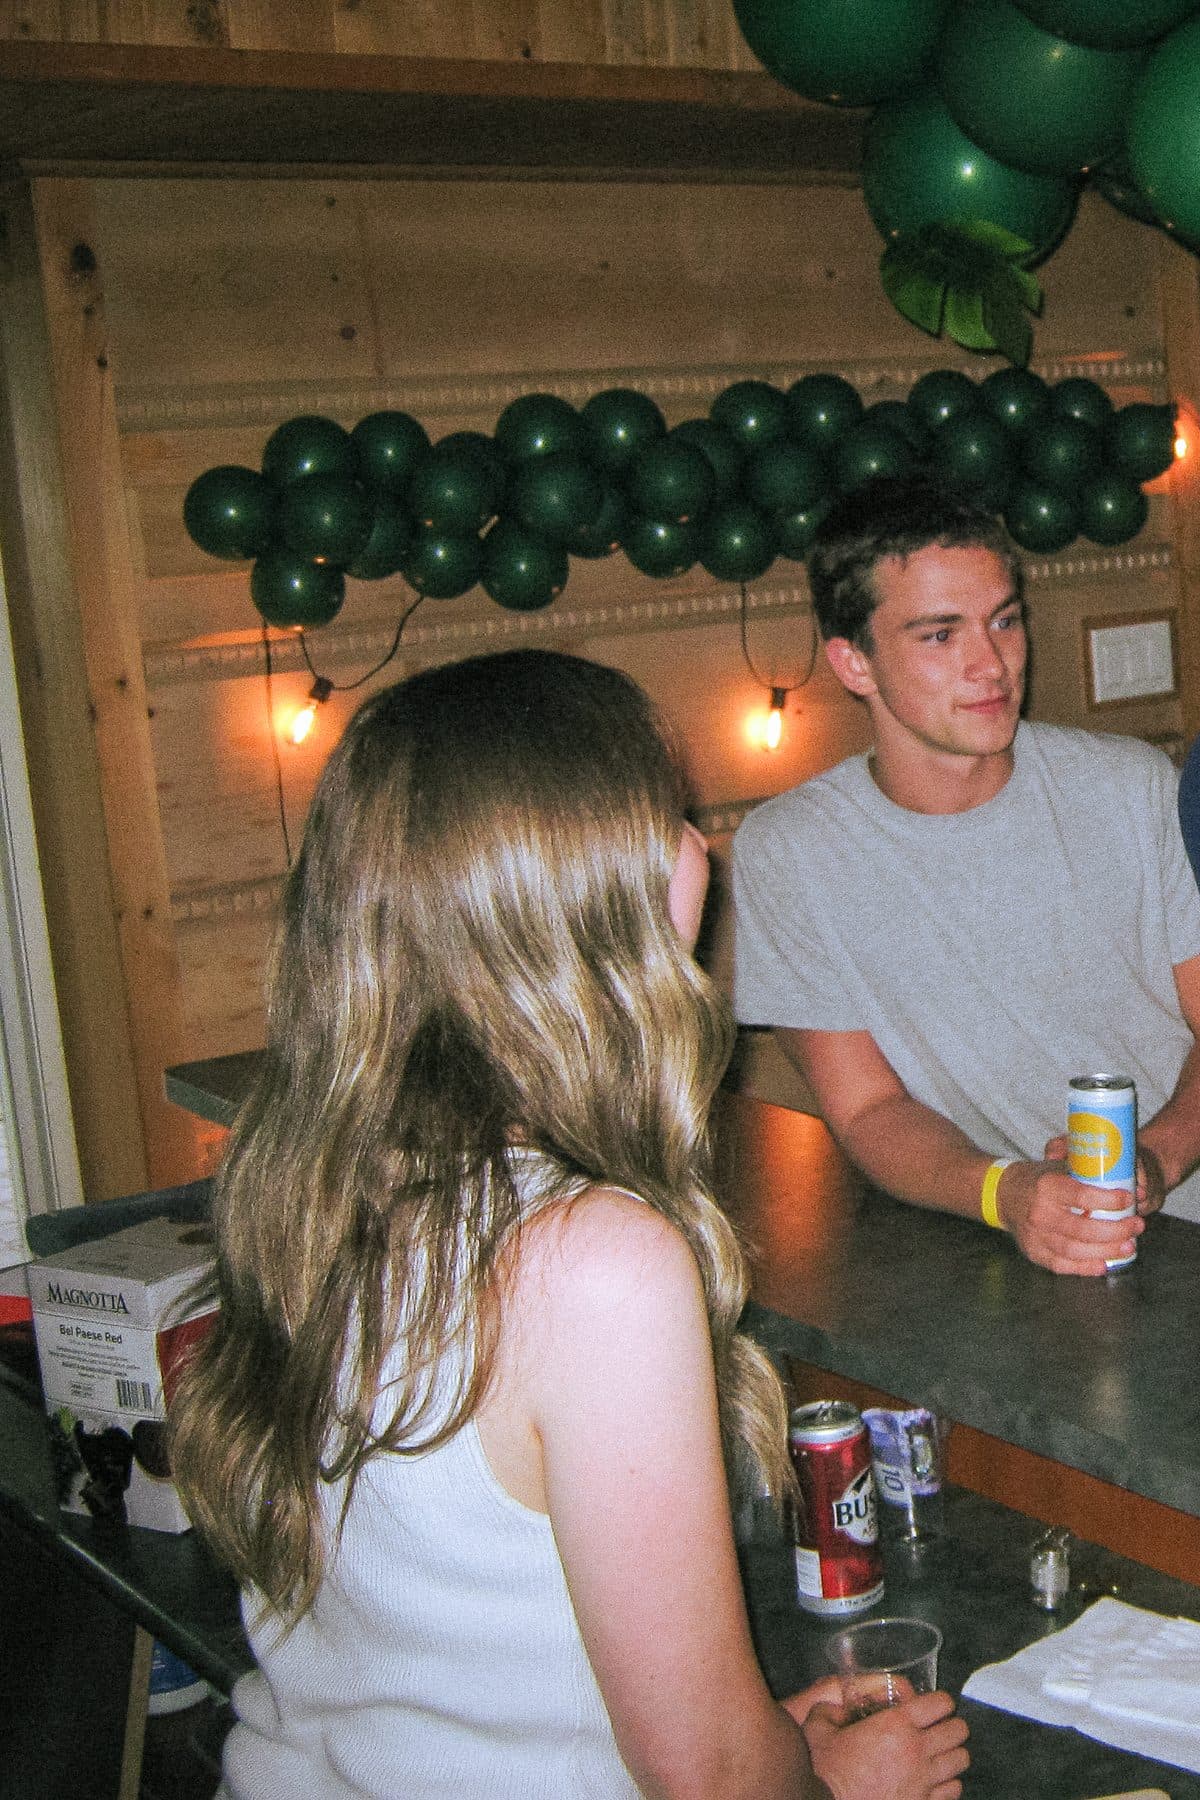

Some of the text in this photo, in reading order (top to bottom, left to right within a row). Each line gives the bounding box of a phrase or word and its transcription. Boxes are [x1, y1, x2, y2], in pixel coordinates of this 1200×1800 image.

[47, 1282, 130, 1314] MAGNOTTA
[60, 1324, 122, 1344] Bel Paese Red
[836, 1494, 872, 1526] BU
